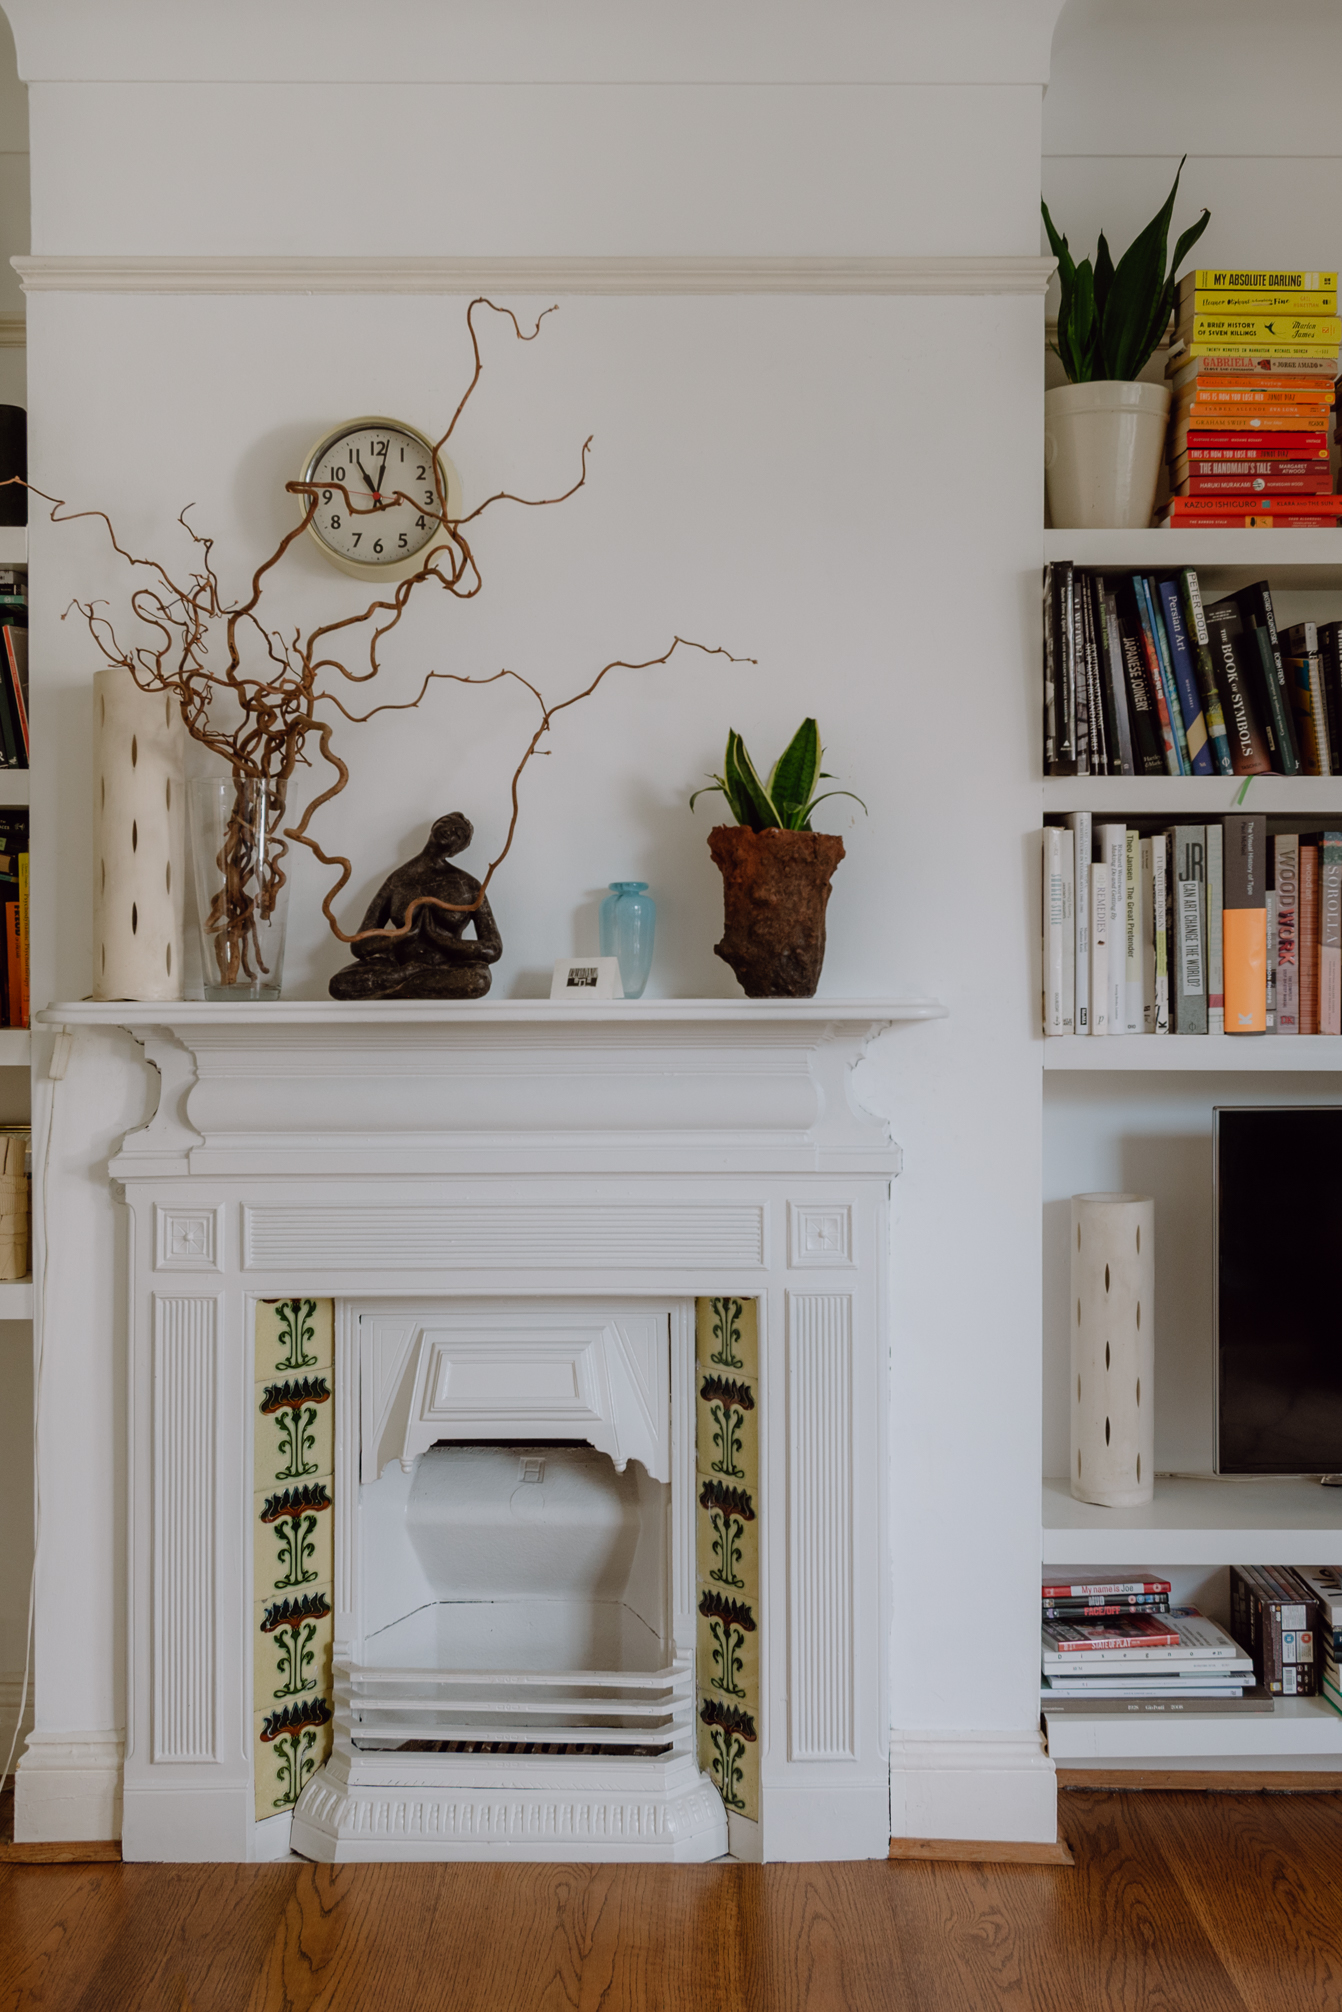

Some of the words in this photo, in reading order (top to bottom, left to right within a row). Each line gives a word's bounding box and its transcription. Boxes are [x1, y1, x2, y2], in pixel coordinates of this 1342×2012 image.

[1214, 274, 1227, 286] MY
[1228, 274, 1266, 286] ABSOLUTE
[1269, 274, 1302, 287] DARLING
[1292, 321, 1316, 330] Marlon
[1292, 330, 1314, 338] James
[1203, 358, 1257, 368] GABRIELA,
[370, 441, 386, 456] 12
[400, 448, 404, 462] 1
[331, 467, 346, 481] 10
[416, 466, 426, 480] 2
[1200, 463, 1212, 474] THE
[1257, 463, 1271, 474] TALE
[322, 490, 333, 505] 9
[424, 490, 434, 505] 3
[331, 515, 341, 529] 8
[415, 515, 426, 530] 4
[352, 533, 362, 547] 7
[373, 538, 383, 554] 6
[398, 533, 407, 548] 5
[1189, 574, 1201, 608] PETER
[1196, 613, 1208, 640] DOIG
[1168, 596, 1181, 632] Persian
[1175, 635, 1186, 651] Art
[1123, 638, 1142, 677] JAPANESE
[1222, 644, 1238, 683] BOOK
[1131, 679, 1149, 711] JOINERY
[1231, 683, 1238, 693] OF
[1232, 693, 1253, 756] SYMBOLS
[1179, 843, 1203, 882] JR
[1112, 868, 1117, 876] Do
[1183, 884, 1196, 898] CAN
[1097, 887, 1106, 932] REMEDIES
[1184, 900, 1197, 912] ART
[1327, 866, 1339, 943] SOROLLA
[1184, 915, 1198, 942] CHANGE
[1186, 944, 1199, 957] THE
[1186, 959, 1200, 987] WORLD?
[1281, 1016, 1295, 1025] DK
[1082, 1586, 1092, 1595] My
[1088, 1596, 1105, 1606] MUD
[1084, 1606, 1120, 1616] FACE/OFF
[1092, 1640, 1108, 1649] STATE
[1116, 1639, 1131, 1648] PLAY
